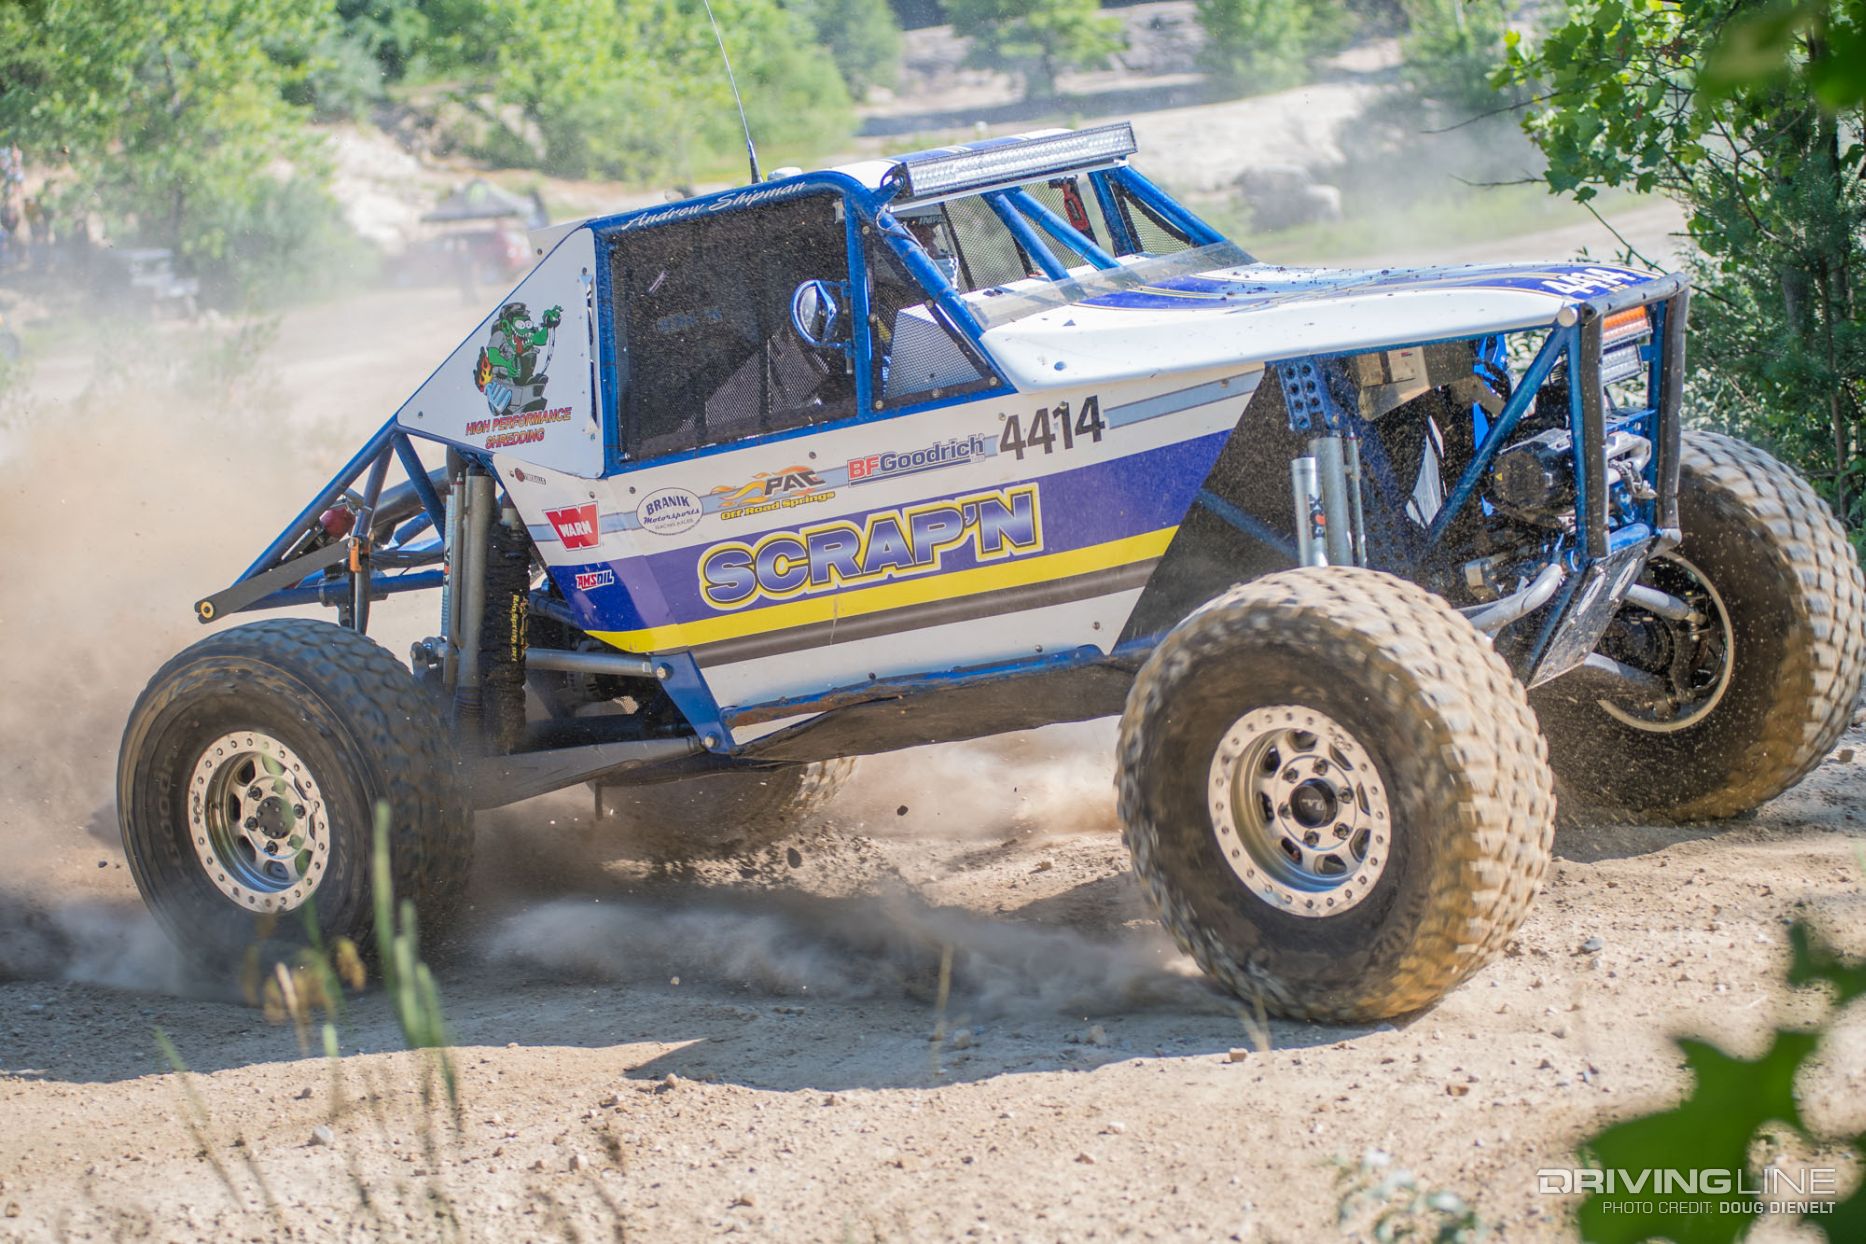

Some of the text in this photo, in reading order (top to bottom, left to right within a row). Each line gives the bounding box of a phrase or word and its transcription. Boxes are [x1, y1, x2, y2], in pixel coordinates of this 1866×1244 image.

[621, 181, 807, 230] Andrew Shipman
[465, 407, 572, 436] HIGH PERFORMANCE
[999, 394, 1105, 461] 4414
[485, 428, 545, 449] SHREDDING
[848, 436, 984, 480] BFGoodrich
[764, 470, 826, 496] PAC
[643, 508, 700, 525] Motorsports
[646, 495, 690, 516] BRANIK
[720, 491, 835, 520] Off Road Springs
[558, 520, 593, 538] WARN
[701, 487, 1040, 607] SCRAP'N
[575, 570, 613, 590] AMSOIL
